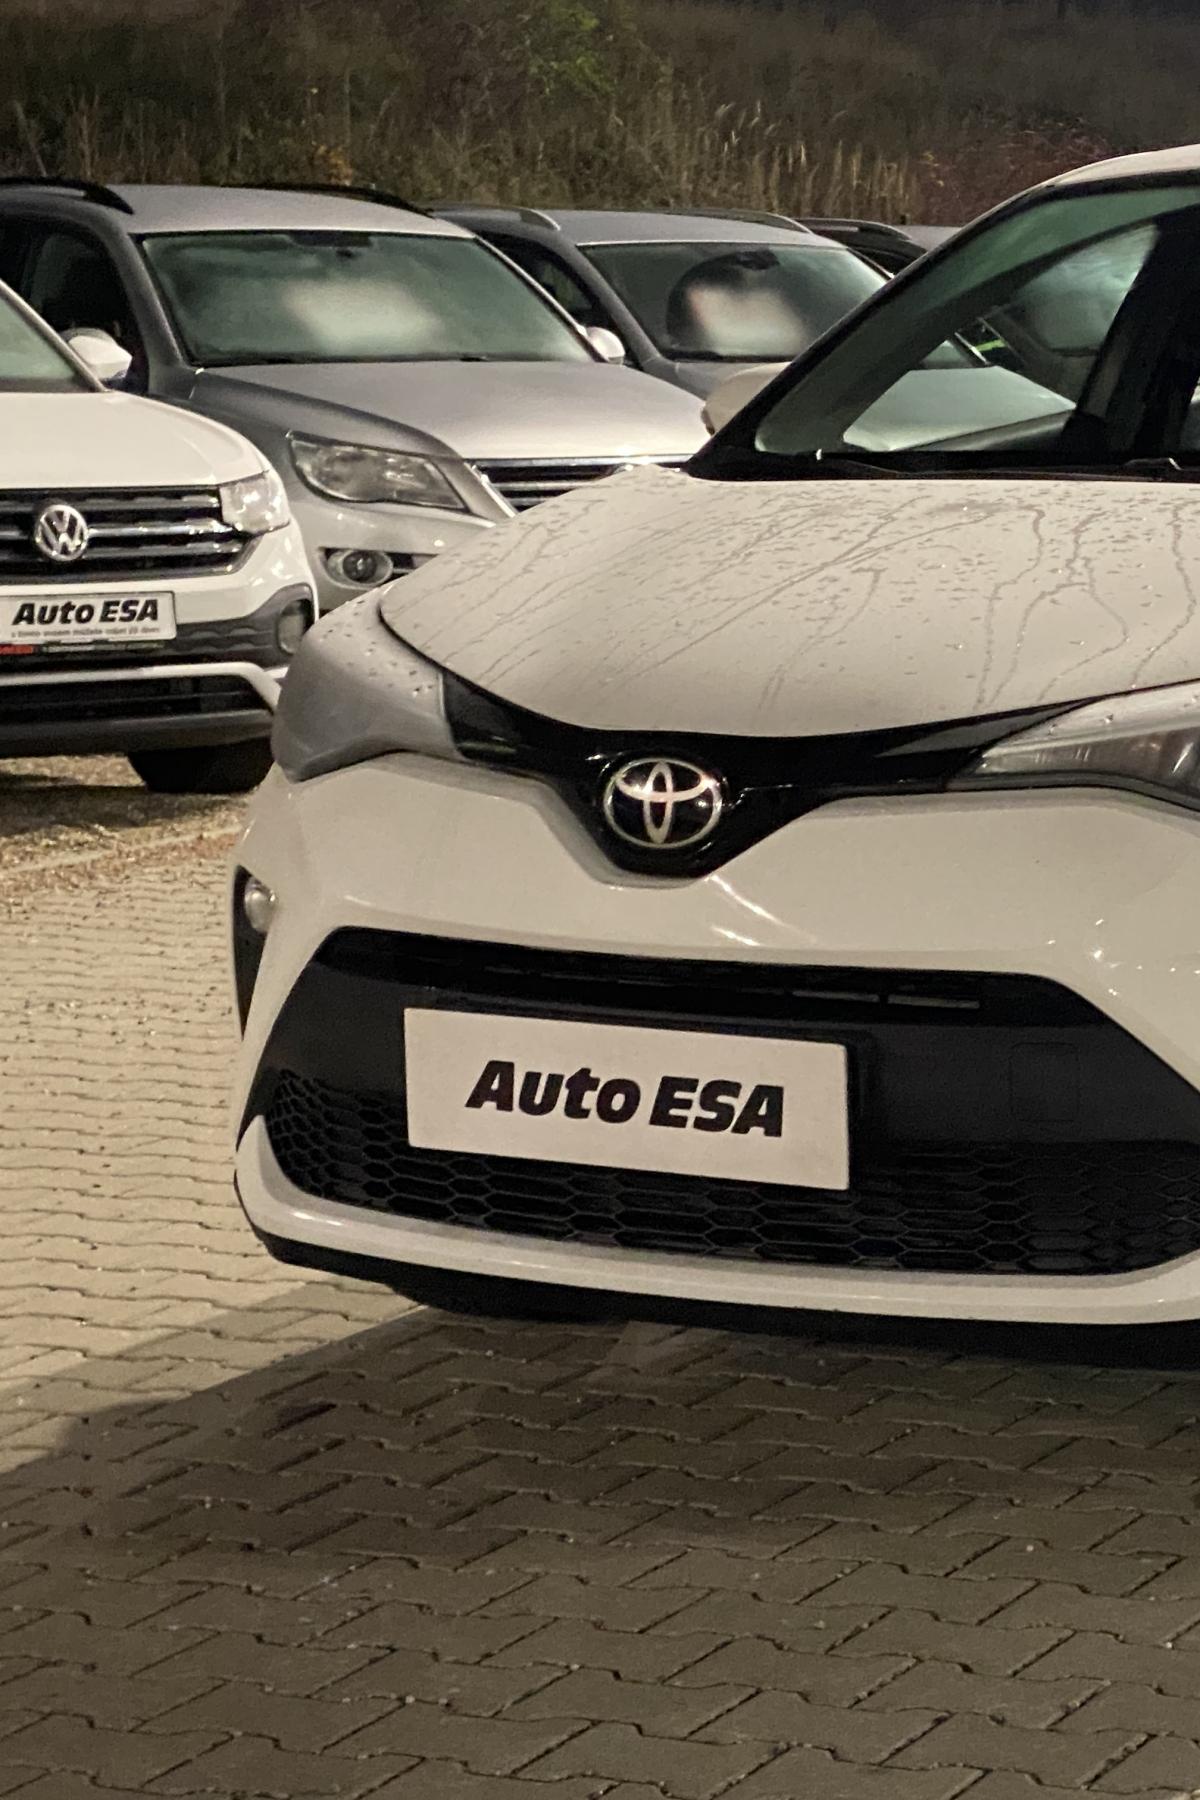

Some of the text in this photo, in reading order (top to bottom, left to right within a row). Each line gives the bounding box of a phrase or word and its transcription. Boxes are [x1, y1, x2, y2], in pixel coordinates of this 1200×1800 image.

[12, 599, 158, 625] Auto ESA
[465, 1060, 784, 1137] Auto ESA
